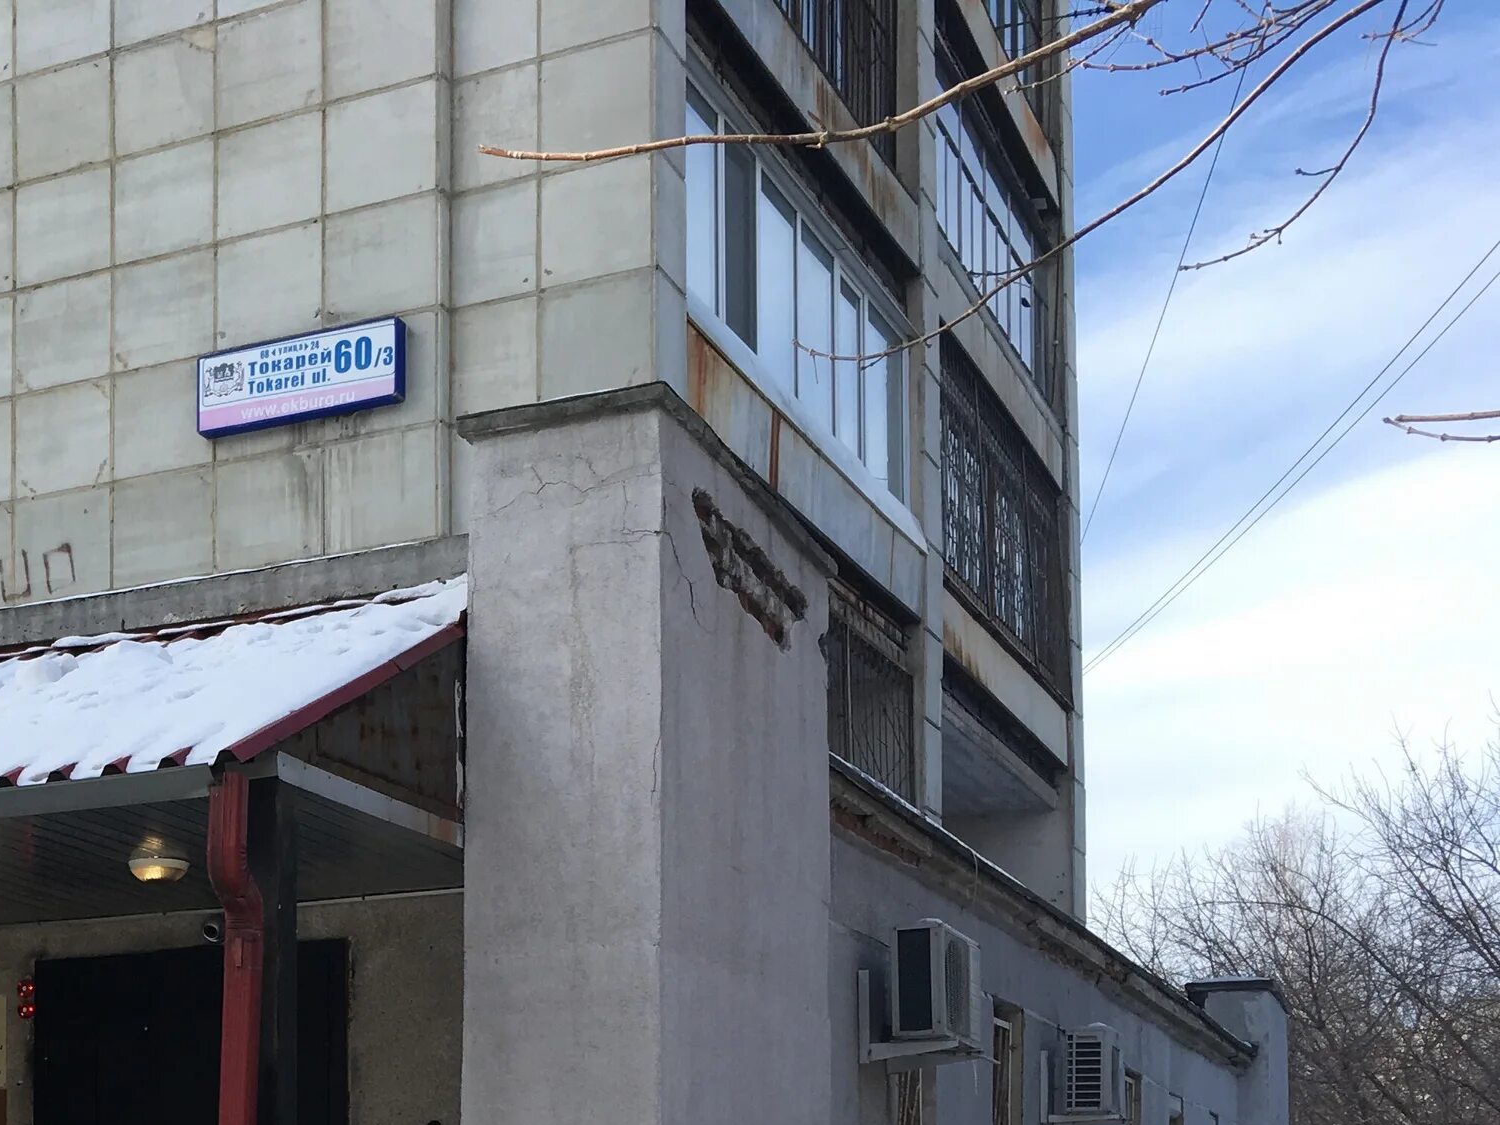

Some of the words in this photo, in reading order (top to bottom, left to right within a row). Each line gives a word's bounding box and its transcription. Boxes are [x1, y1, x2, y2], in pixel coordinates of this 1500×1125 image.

[248, 347, 332, 377] Токарей
[278, 343, 303, 356] улица
[248, 372, 305, 395] Tokarei
[312, 368, 331, 385] ul.
[240, 391, 356, 420] www.ekburg.ru
